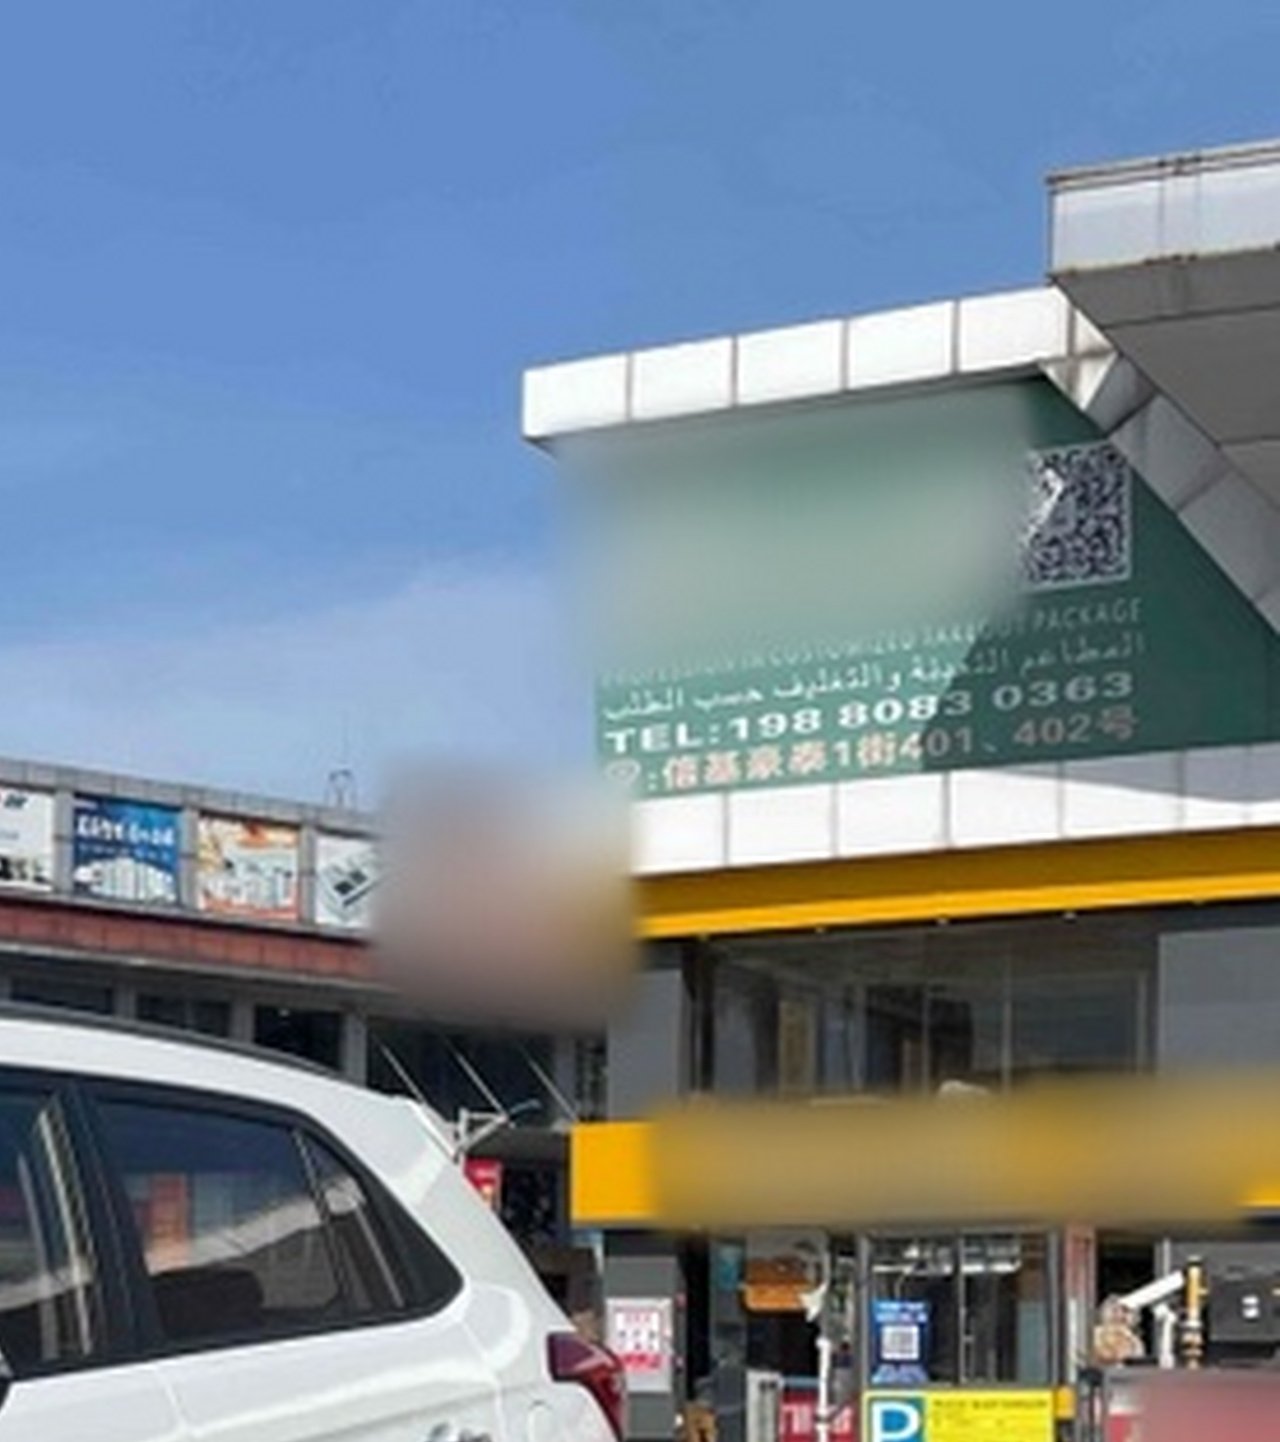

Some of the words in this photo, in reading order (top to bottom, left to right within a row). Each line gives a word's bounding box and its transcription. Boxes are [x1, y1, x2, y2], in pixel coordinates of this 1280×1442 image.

[1034, 597, 1143, 632] PACKAGE
[604, 707, 822, 754] TEL:198
[837, 688, 973, 729] 8083
[991, 670, 1134, 712] 0363
